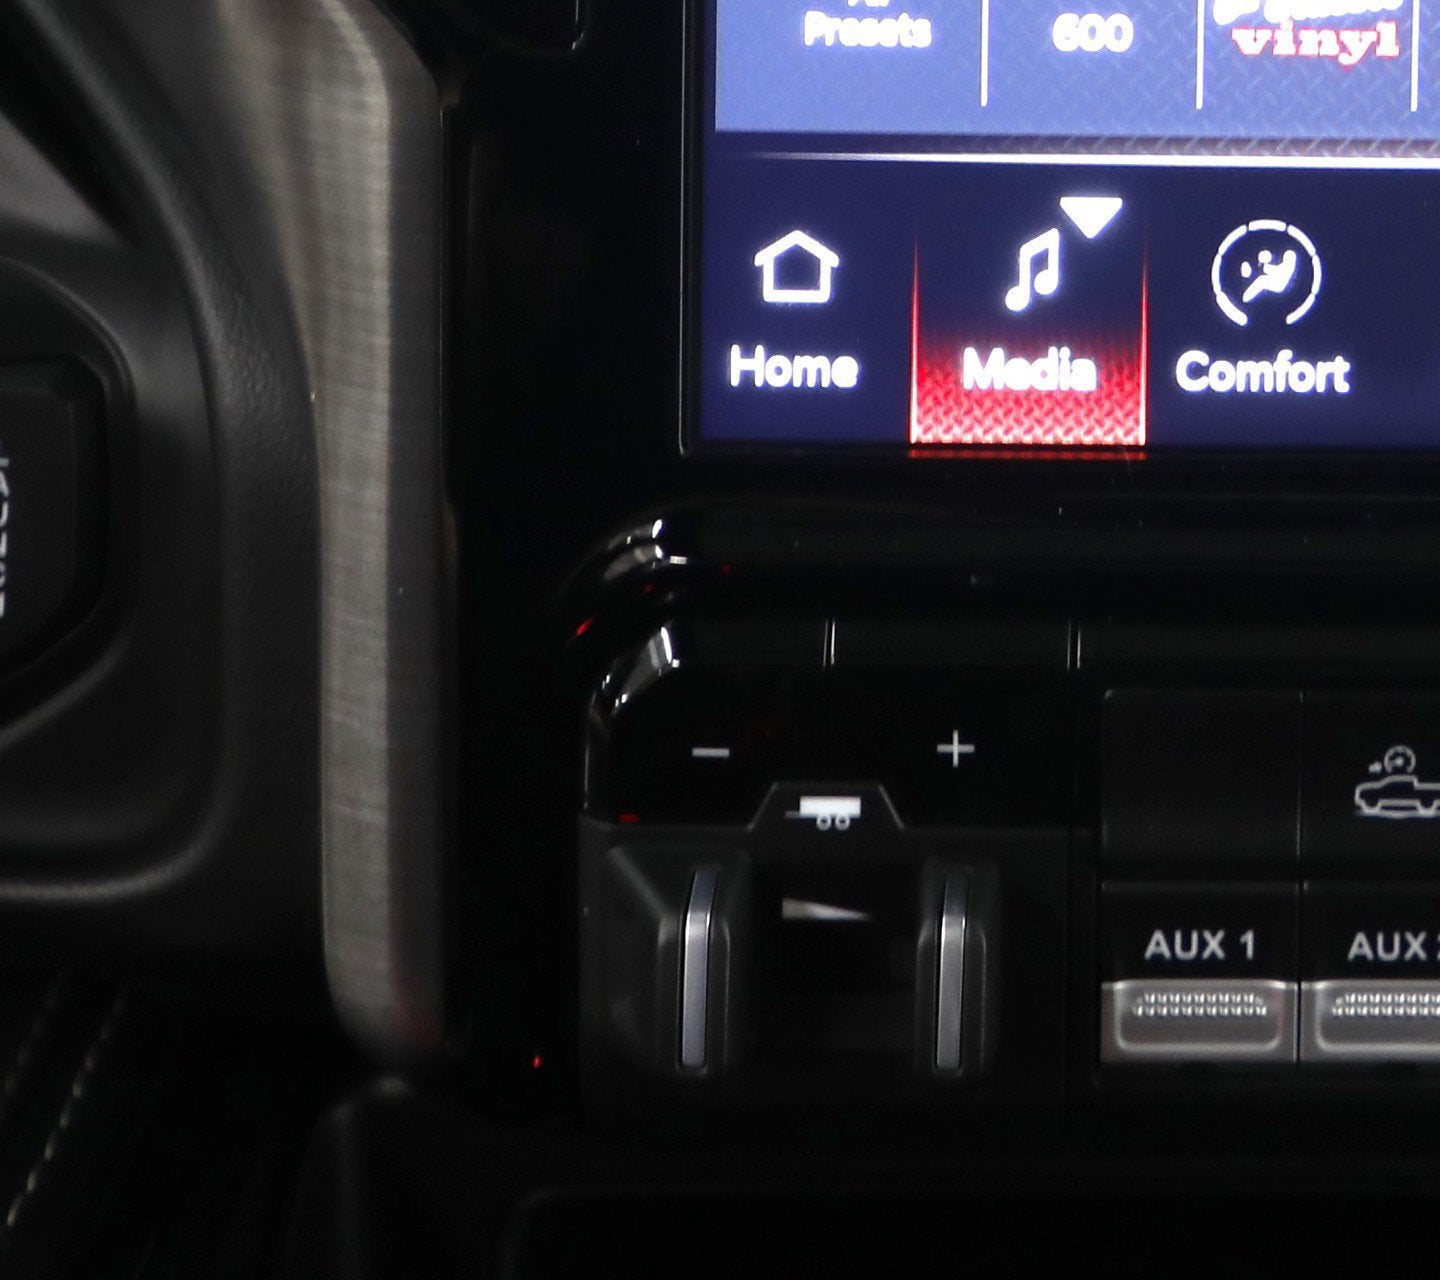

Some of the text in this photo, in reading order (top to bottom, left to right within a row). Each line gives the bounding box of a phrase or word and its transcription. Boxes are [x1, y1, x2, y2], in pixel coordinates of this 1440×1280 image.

[803, 11, 932, 49] Presets
[1051, 12, 1134, 52] 600
[1230, 20, 1400, 69] vinyl
[728, 344, 859, 390] Home
[962, 346, 1098, 394] Media
[1175, 349, 1351, 395] Comfort
[1144, 929, 1257, 961] AUX 1
[1347, 931, 1428, 963] AUX
